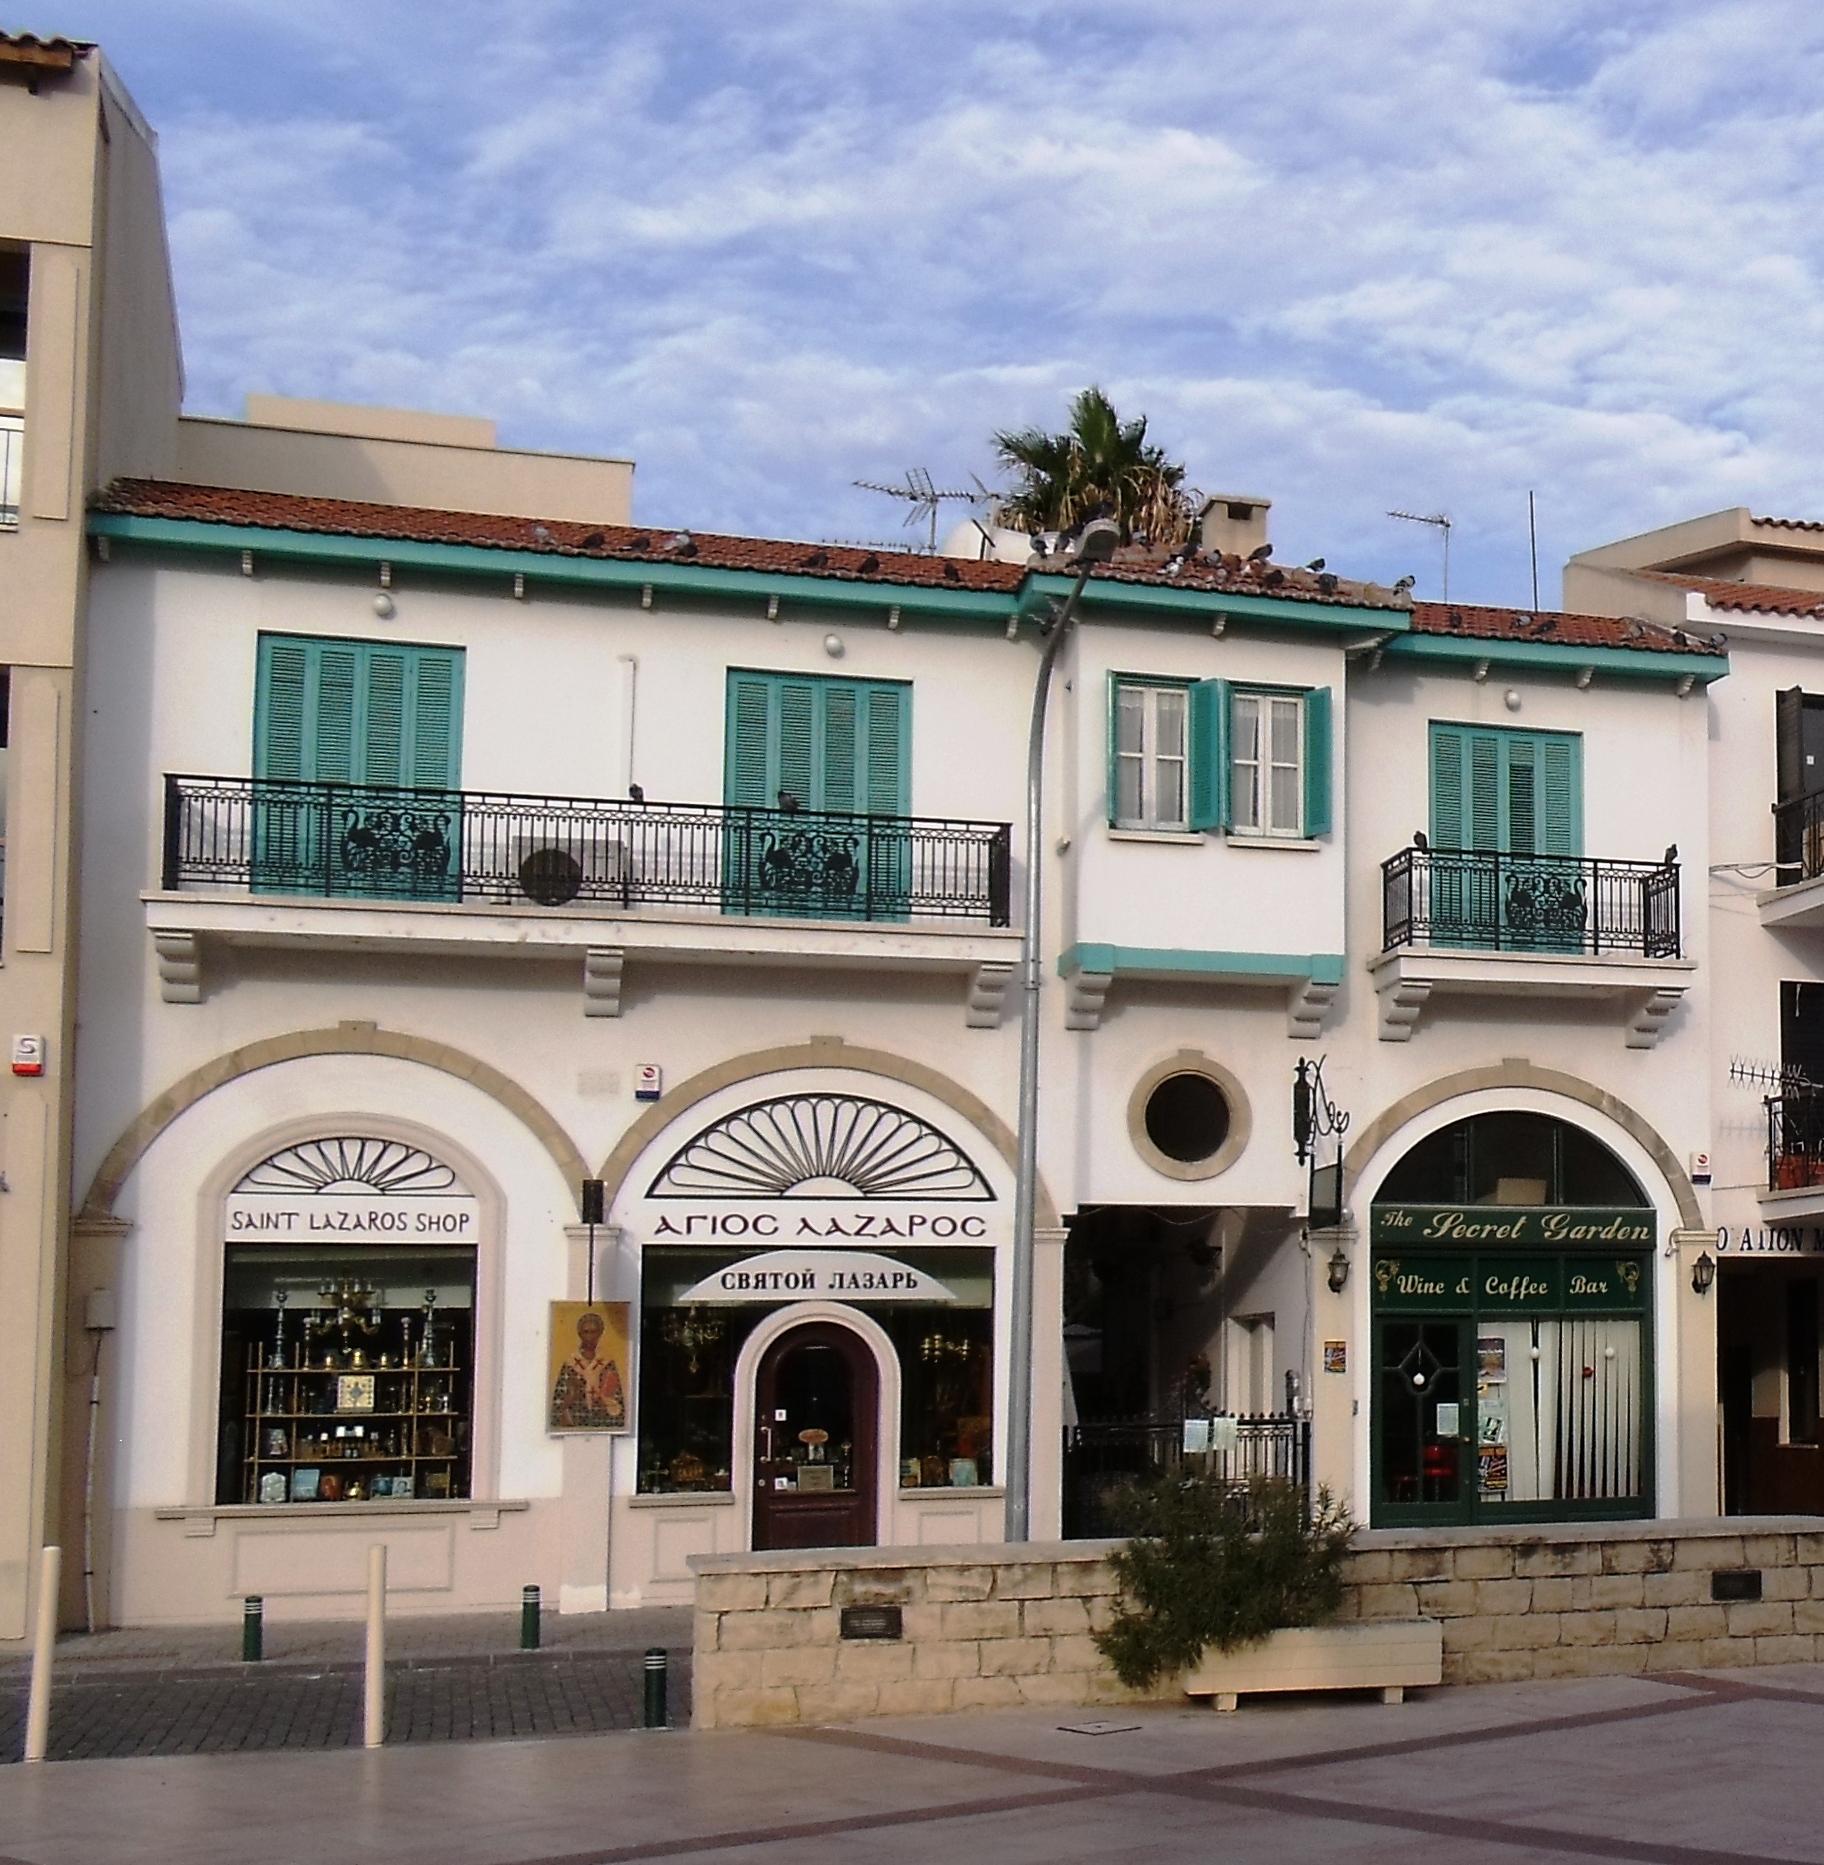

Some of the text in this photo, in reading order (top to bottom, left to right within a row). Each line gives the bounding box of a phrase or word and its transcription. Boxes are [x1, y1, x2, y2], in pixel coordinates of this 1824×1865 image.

[231, 1211, 470, 1232] SAINT LAZAROS SHOP
[1380, 1211, 1650, 1240] The Secret Garden
[720, 1268, 919, 1290] СВЯТОЙ ЛАЗАРЬ
[1397, 1275, 1608, 1300] Wine & Coffee Bar
